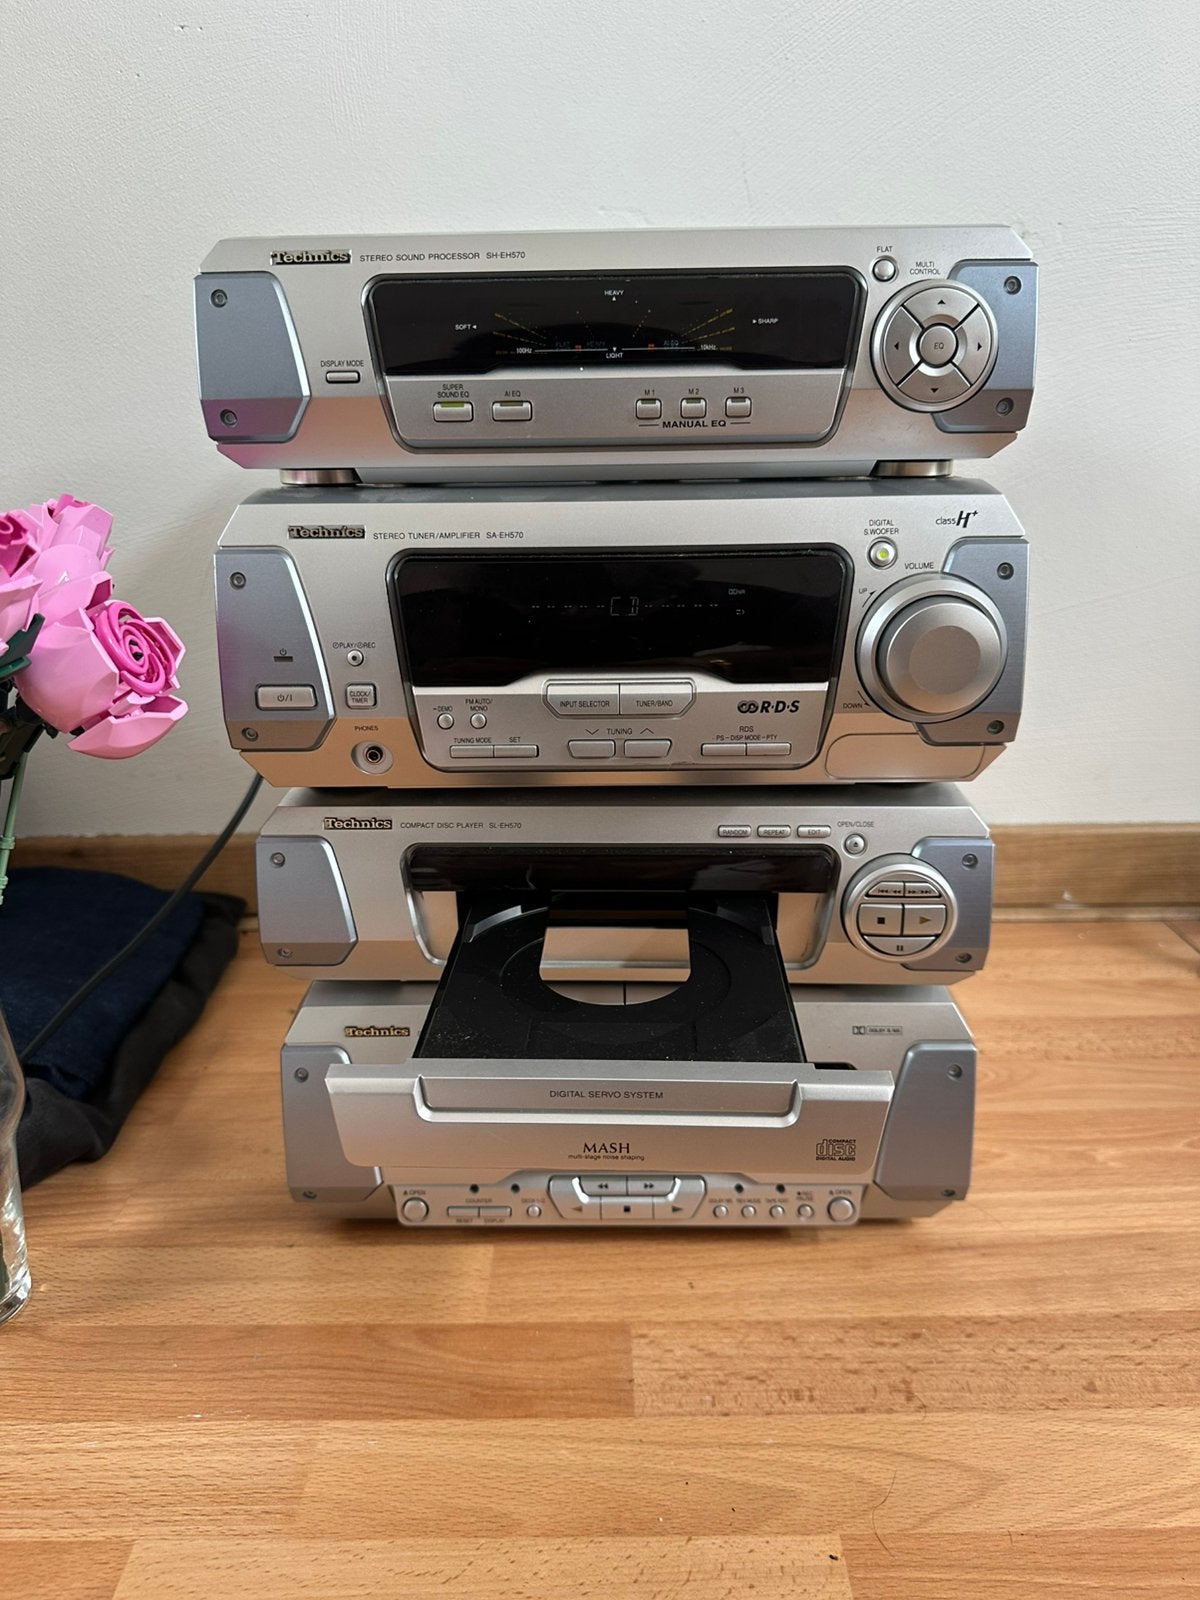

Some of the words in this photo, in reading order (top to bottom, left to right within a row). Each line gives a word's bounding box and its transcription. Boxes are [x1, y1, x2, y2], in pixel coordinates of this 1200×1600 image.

[270, 250, 350, 265] Technics
[360, 254, 393, 262] STEREO
[396, 253, 426, 261] SOUND
[428, 252, 480, 261] PROCESSOR
[486, 251, 526, 260] SH-EH570
[933, 342, 945, 350] EQ
[662, 421, 709, 429] MANUAL
[711, 419, 727, 427] EQ
[288, 525, 365, 539] Technics
[373, 532, 406, 540] STEREO
[408, 531, 481, 540] TUNER/AMPLIFIER
[486, 531, 524, 539] SA-EH570
[863, 527, 899, 535] S.WOOFER
[904, 561, 935, 570] VOLUME
[560, 700, 578, 708] INPUT
[578, 700, 610, 708] SELECTOR
[636, 700, 674, 708] TUNER/BAND
[739, 725, 754, 733] RDS
[324, 817, 393, 830] Technics
[837, 820, 875, 828] OPEN/CLOSE
[345, 1025, 410, 1037] Technics
[549, 1090, 586, 1098] DIGITAL
[588, 1090, 621, 1098] SERVO
[623, 1091, 664, 1099] SYSTEM
[583, 1142, 630, 1154] MASH
[815, 1138, 857, 1157] disc
[568, 1153, 601, 1161] multi-stage
